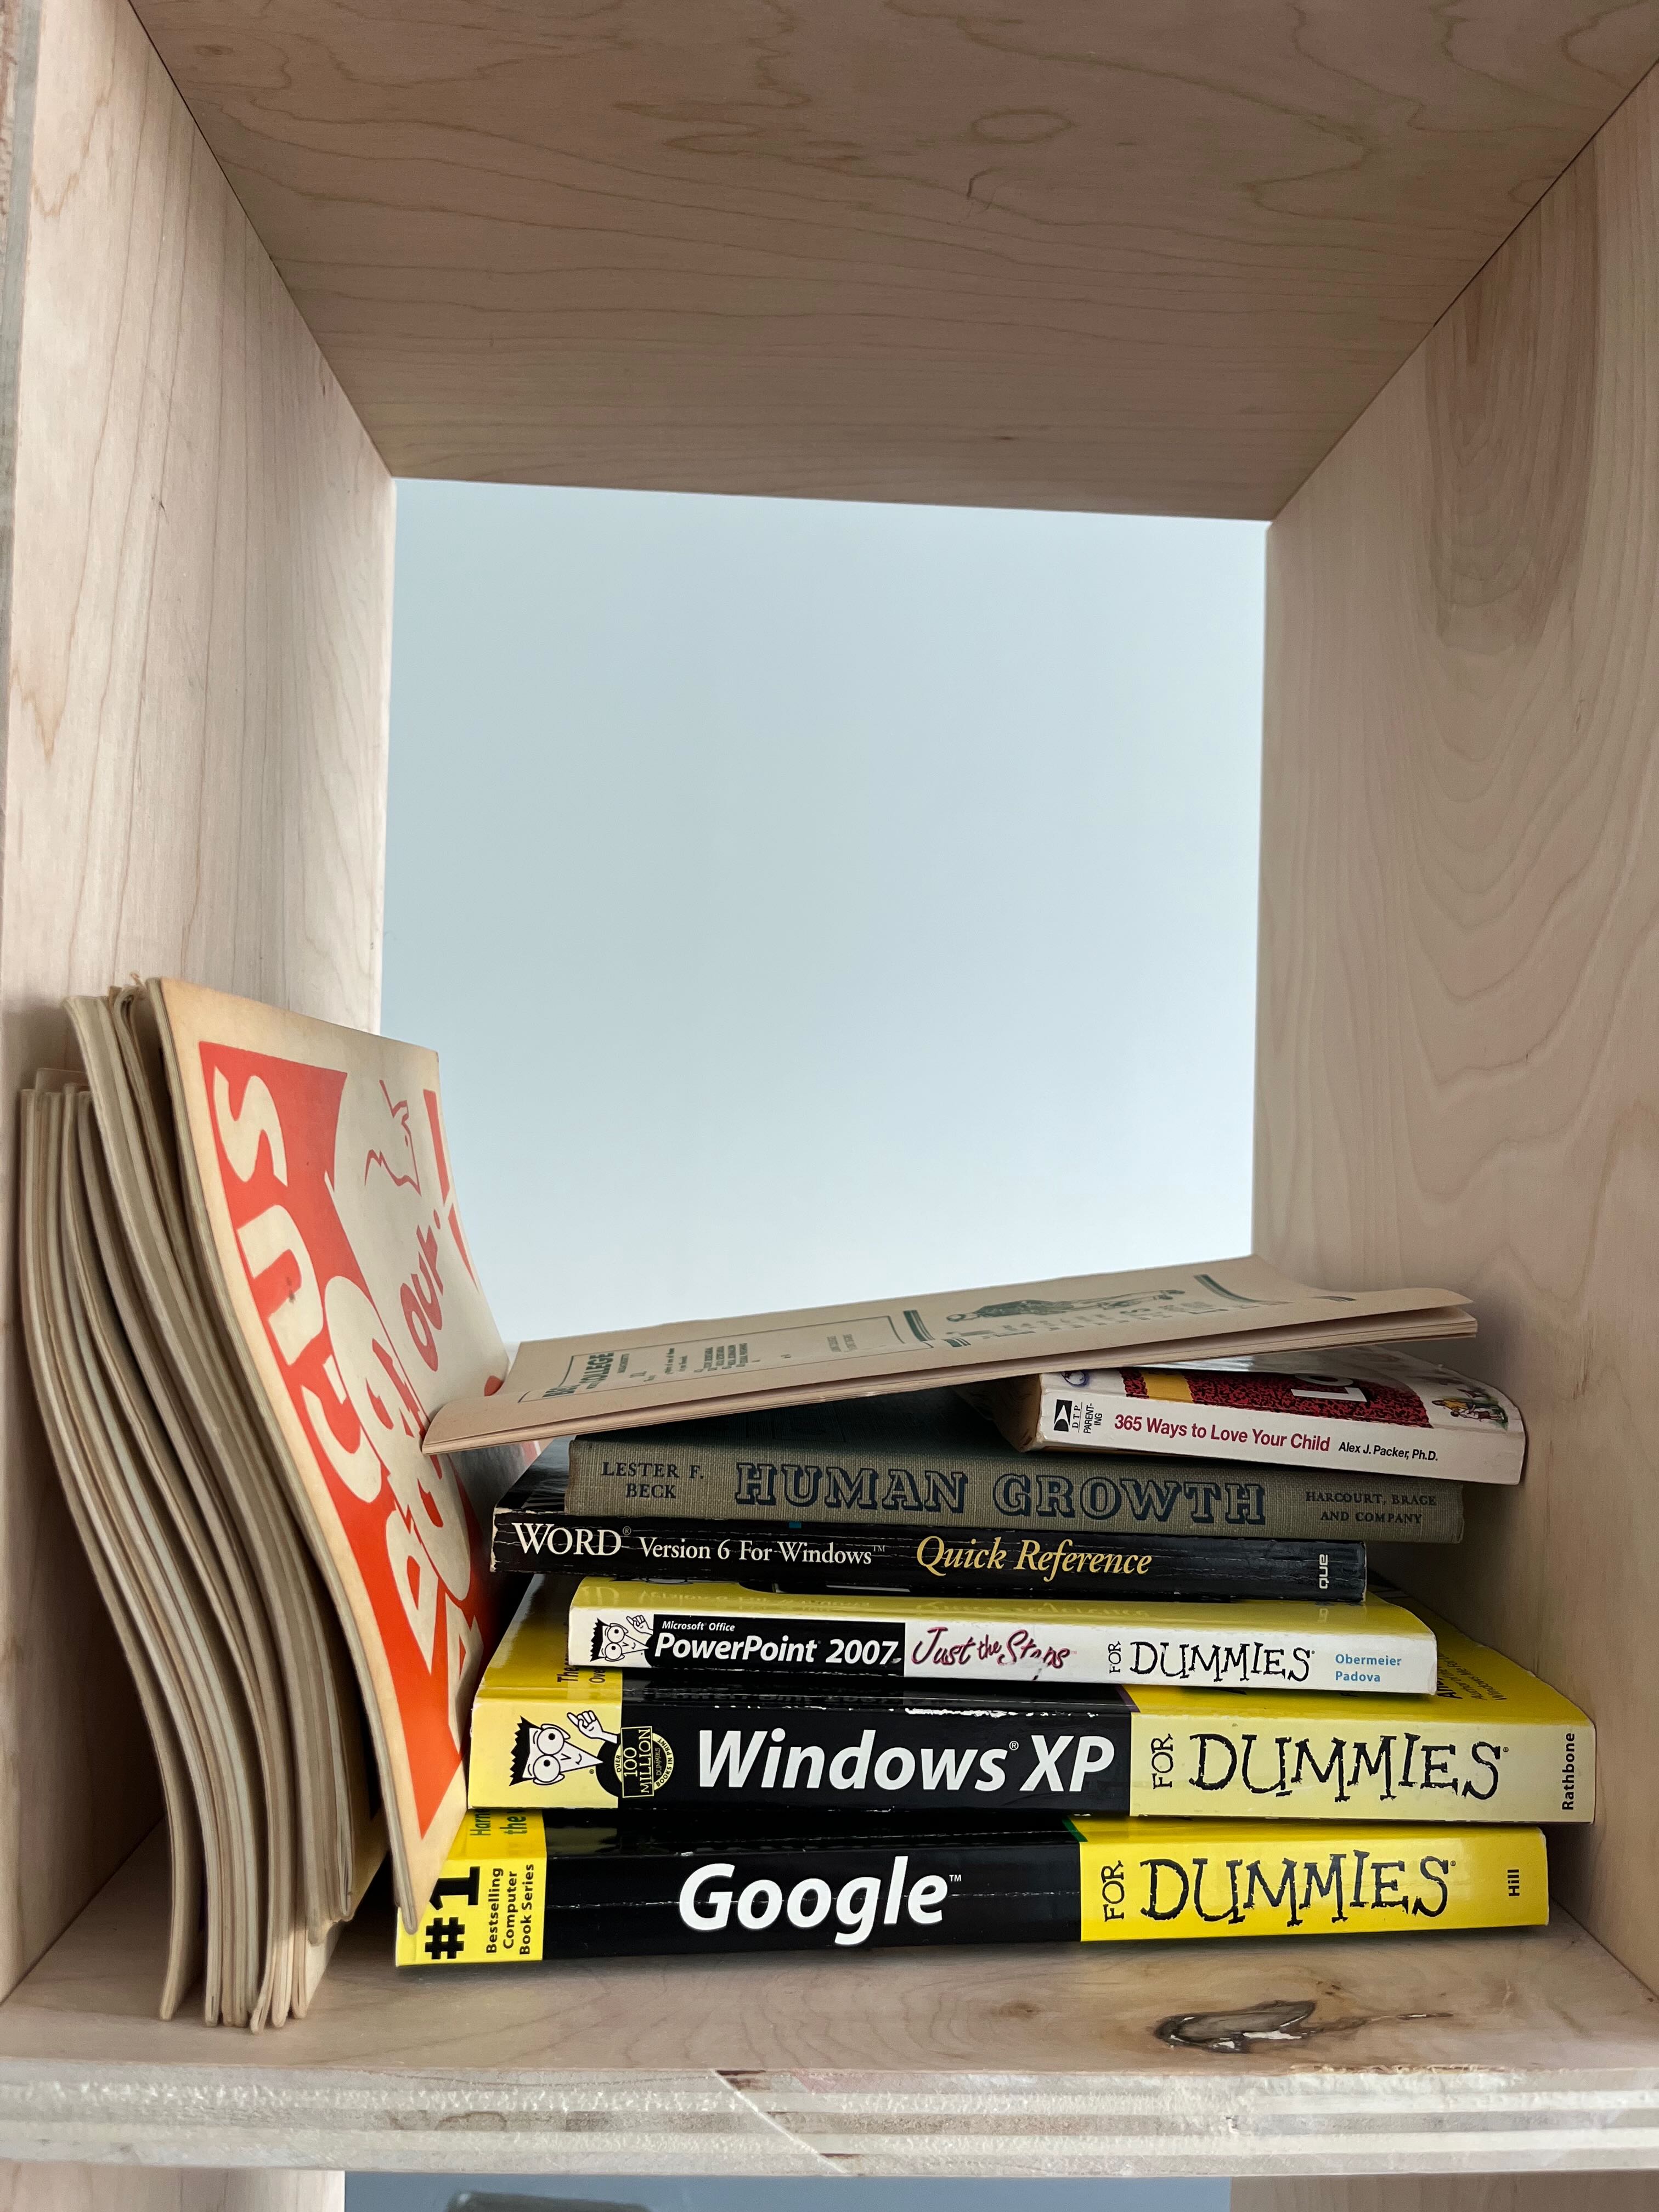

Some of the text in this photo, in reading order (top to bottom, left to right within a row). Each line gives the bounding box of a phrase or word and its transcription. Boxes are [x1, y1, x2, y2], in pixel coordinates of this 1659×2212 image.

[1093, 1413, 1103, 1426] ING
[1115, 1414, 1330, 1452] 365 Ways to Love Your Child
[1338, 1441, 1438, 1462] Alex J. Packer, Ph.D.
[601, 1461, 704, 1480] LESTER F.
[625, 1482, 677, 1499] BECK
[735, 1462, 1267, 1526] HUMAN GROWTH
[1305, 1491, 1387, 1506] HARCOURT,
[1320, 1511, 1423, 1525] AND COMPANY
[640, 1537, 712, 1560] Version
[716, 1539, 731, 1561] 6
[738, 1540, 774, 1561] For
[916, 1536, 1007, 1577] Quick
[1013, 1539, 1153, 1582] Reference
[1319, 1554, 1330, 1590] que
[662, 1621, 736, 1632] Microsoft Office
[654, 1632, 899, 1666] PowerPoint 2007
[911, 1626, 975, 1666] Just
[977, 1634, 1002, 1660] the
[1108, 1640, 1122, 1674] FOR
[1335, 1653, 1402, 1667] Obermeier
[556, 1668, 579, 1683] The
[1335, 1671, 1381, 1683] Padova
[623, 1747, 638, 1777] 100
[638, 1729, 652, 1793] MILLION
[658, 1738, 672, 1755] PRINT
[1019, 1735, 1115, 1792] XP
[1151, 1733, 1173, 1790] FOR
[656, 1766, 673, 1787] BOOKS
[1562, 1733, 1575, 1810] Rathbone
[499, 1816, 528, 1835] the
[1102, 1860, 1124, 1922] FOR
[1508, 1869, 1520, 1897] Hill
[425, 1866, 481, 1960] #1
[486, 1867, 504, 1954] Bestselling
[503, 1871, 518, 1949] Computer
[519, 1864, 534, 1955] Book Series
